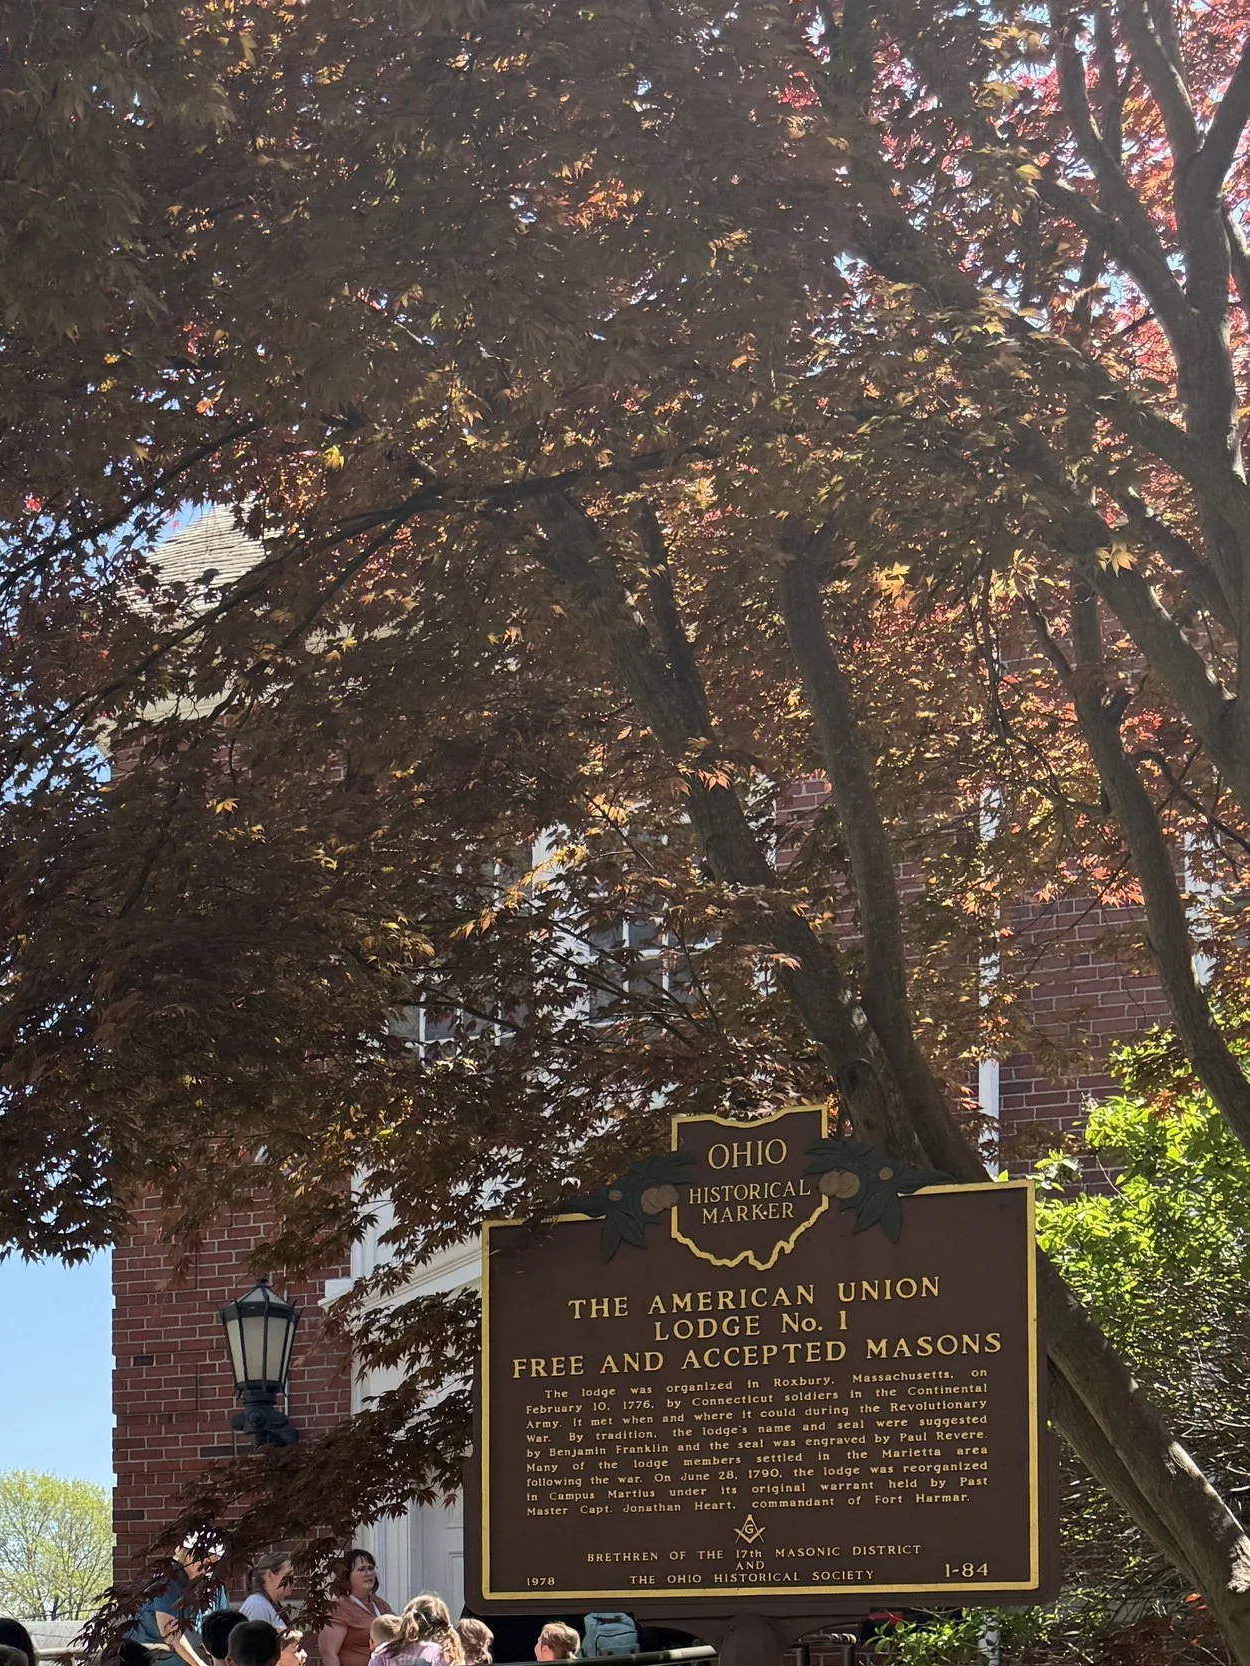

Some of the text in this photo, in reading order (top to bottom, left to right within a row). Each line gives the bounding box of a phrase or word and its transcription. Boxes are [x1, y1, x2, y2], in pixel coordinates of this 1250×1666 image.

[708, 1138, 787, 1169] OHIO
[690, 1179, 811, 1204] HISTORICAL
[702, 1202, 794, 1224] MARKER
[568, 1276, 939, 1319] THE AMERICAN UNION
[654, 1310, 848, 1341] LODGE No. 1
[513, 1332, 1001, 1378] FREE AND ACCEPTED MASONS
[544, 1390, 568, 1399] The
[582, 1388, 616, 1398] lodge
[666, 1380, 732, 1394] organized
[748, 1379, 759, 1388] in
[971, 1369, 987, 1378] on
[526, 1405, 582, 1415] February
[667, 1399, 681, 1409] by
[692, 1394, 773, 1406] Connecticut
[784, 1391, 838, 1402] soldiers
[850, 1389, 862, 1398] in
[875, 1388, 896, 1397] the
[907, 1383, 987, 1396] Continental
[573, 1418, 582, 1427] It
[591, 1417, 612, 1426] met
[622, 1415, 653, 1424] when
[662, 1413, 684, 1423] and
[694, 1412, 733, 1421] where
[742, 1410, 752, 1419] it
[760, 1408, 796, 1418] could
[804, 1405, 849, 1417] during
[860, 1404, 880, 1413] the
[890, 1400, 987, 1412] Revolutionary
[569, 1432, 584, 1443] By
[672, 1428, 692, 1437] the
[702, 1425, 748, 1437] lodge's
[758, 1424, 792, 1433] name
[802, 1421, 826, 1431] and
[837, 1419, 864, 1430] seal
[876, 1419, 908, 1427] were
[919, 1414, 987, 1428] suggested
[526, 1449, 541, 1459] by
[549, 1446, 606, 1458] Benjamin
[616, 1443, 668, 1454] Franklin
[677, 1442, 700, 1451] and
[709, 1441, 729, 1450] the
[738, 1439, 764, 1449] seal
[773, 1439, 796, 1447] was
[805, 1435, 866, 1448] engraved
[874, 1433, 890, 1444] by
[900, 1432, 927, 1442] Paul
[526, 1447, 988, 1473] Many of the lodge members settled in the Marietta area
[527, 1477, 582, 1488] following
[590, 1476, 609, 1485] the
[654, 1473, 671, 1482] On
[680, 1472, 710, 1481] June
[793, 1468, 814, 1477] the
[824, 1466, 860, 1477] lodge
[870, 1466, 894, 1474] was
[903, 1461, 988, 1474] reorganized
[527, 1477, 988, 1502] in Campus Martius under its original warrant held by Past
[527, 1507, 568, 1516] Master
[623, 1503, 681, 1513] Jonathan
[752, 1498, 834, 1508] commandant
[848, 1495, 861, 1505] of
[875, 1495, 902, 1504] Fort
[588, 1545, 921, 1562] BRETHREN OF THE 17th MASONIC DISTRICT
[736, 1560, 764, 1571] AND
[527, 1577, 555, 1586] 1978
[630, 1570, 874, 1584] THE OHIO HISTORICAL SOCIETY
[946, 1562, 988, 1578] 1-84
